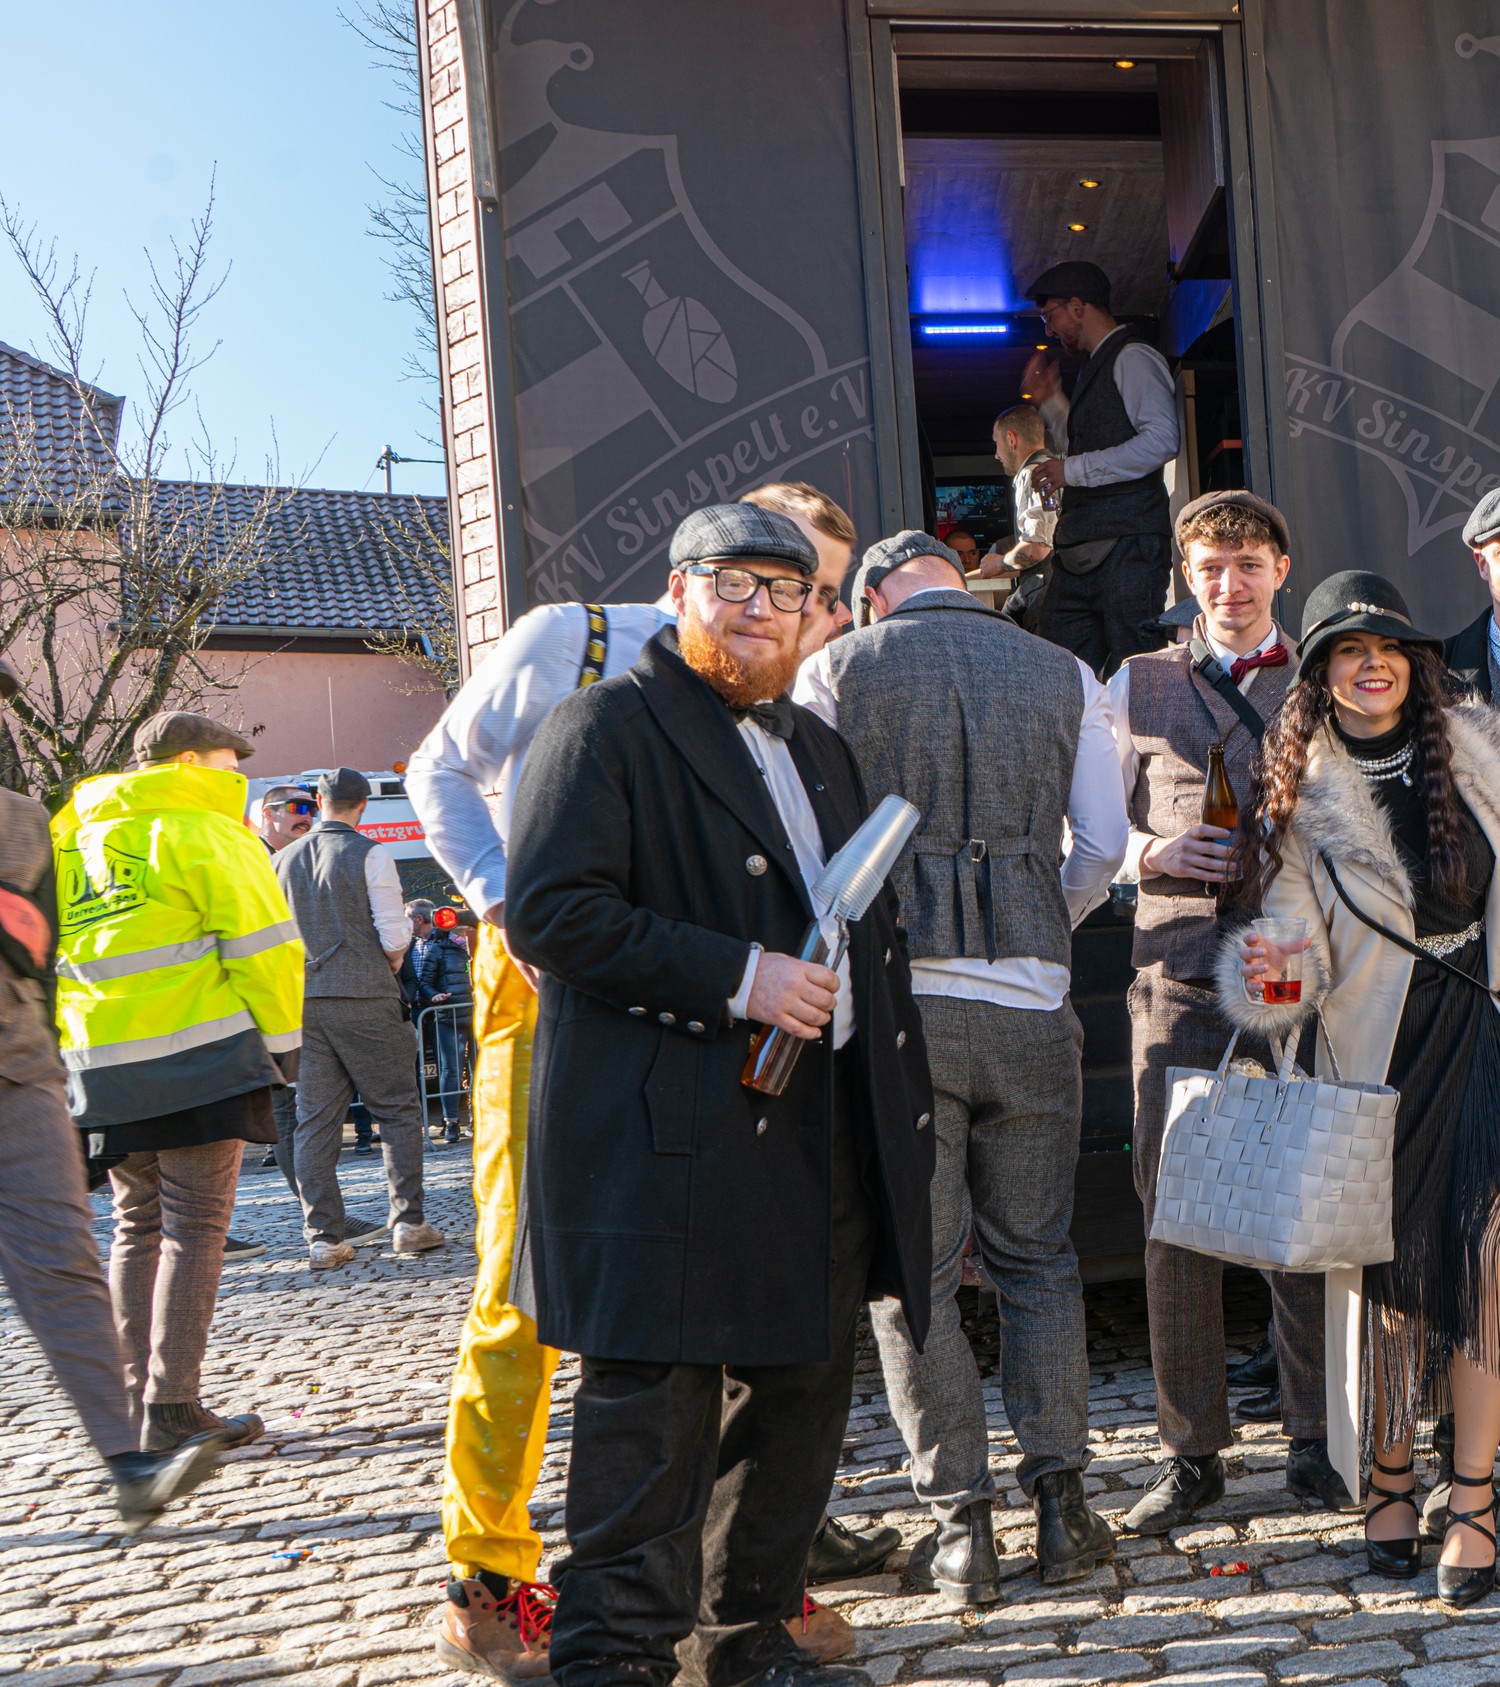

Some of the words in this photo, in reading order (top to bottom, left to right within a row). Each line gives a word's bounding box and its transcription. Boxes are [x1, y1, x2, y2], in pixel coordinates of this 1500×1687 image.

[1285, 367, 1356, 423] KV
[534, 533, 606, 603] KV
[606, 412, 791, 555] Sinspelt
